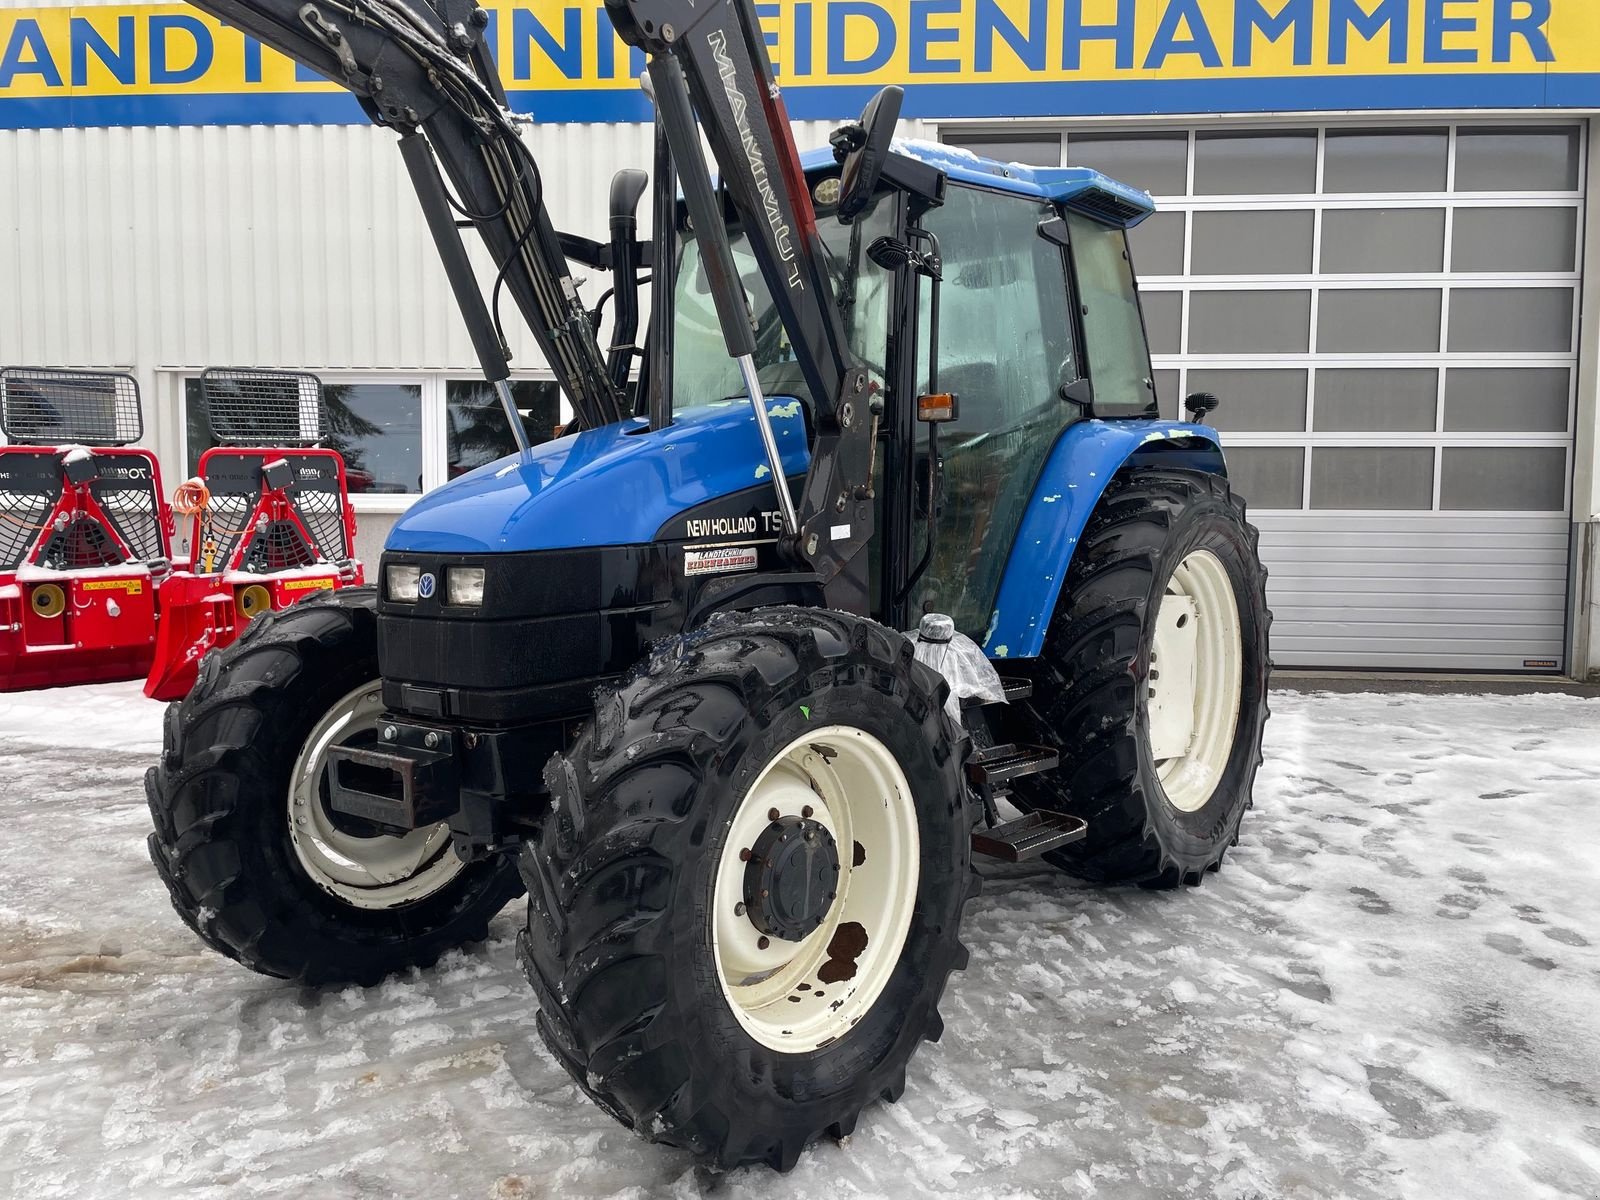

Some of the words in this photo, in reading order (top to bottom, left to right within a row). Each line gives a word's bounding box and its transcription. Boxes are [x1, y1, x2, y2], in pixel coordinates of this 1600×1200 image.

[686, 519, 711, 537] NEW
[711, 517, 757, 536] HOLLAND
[761, 511, 783, 532] TS
